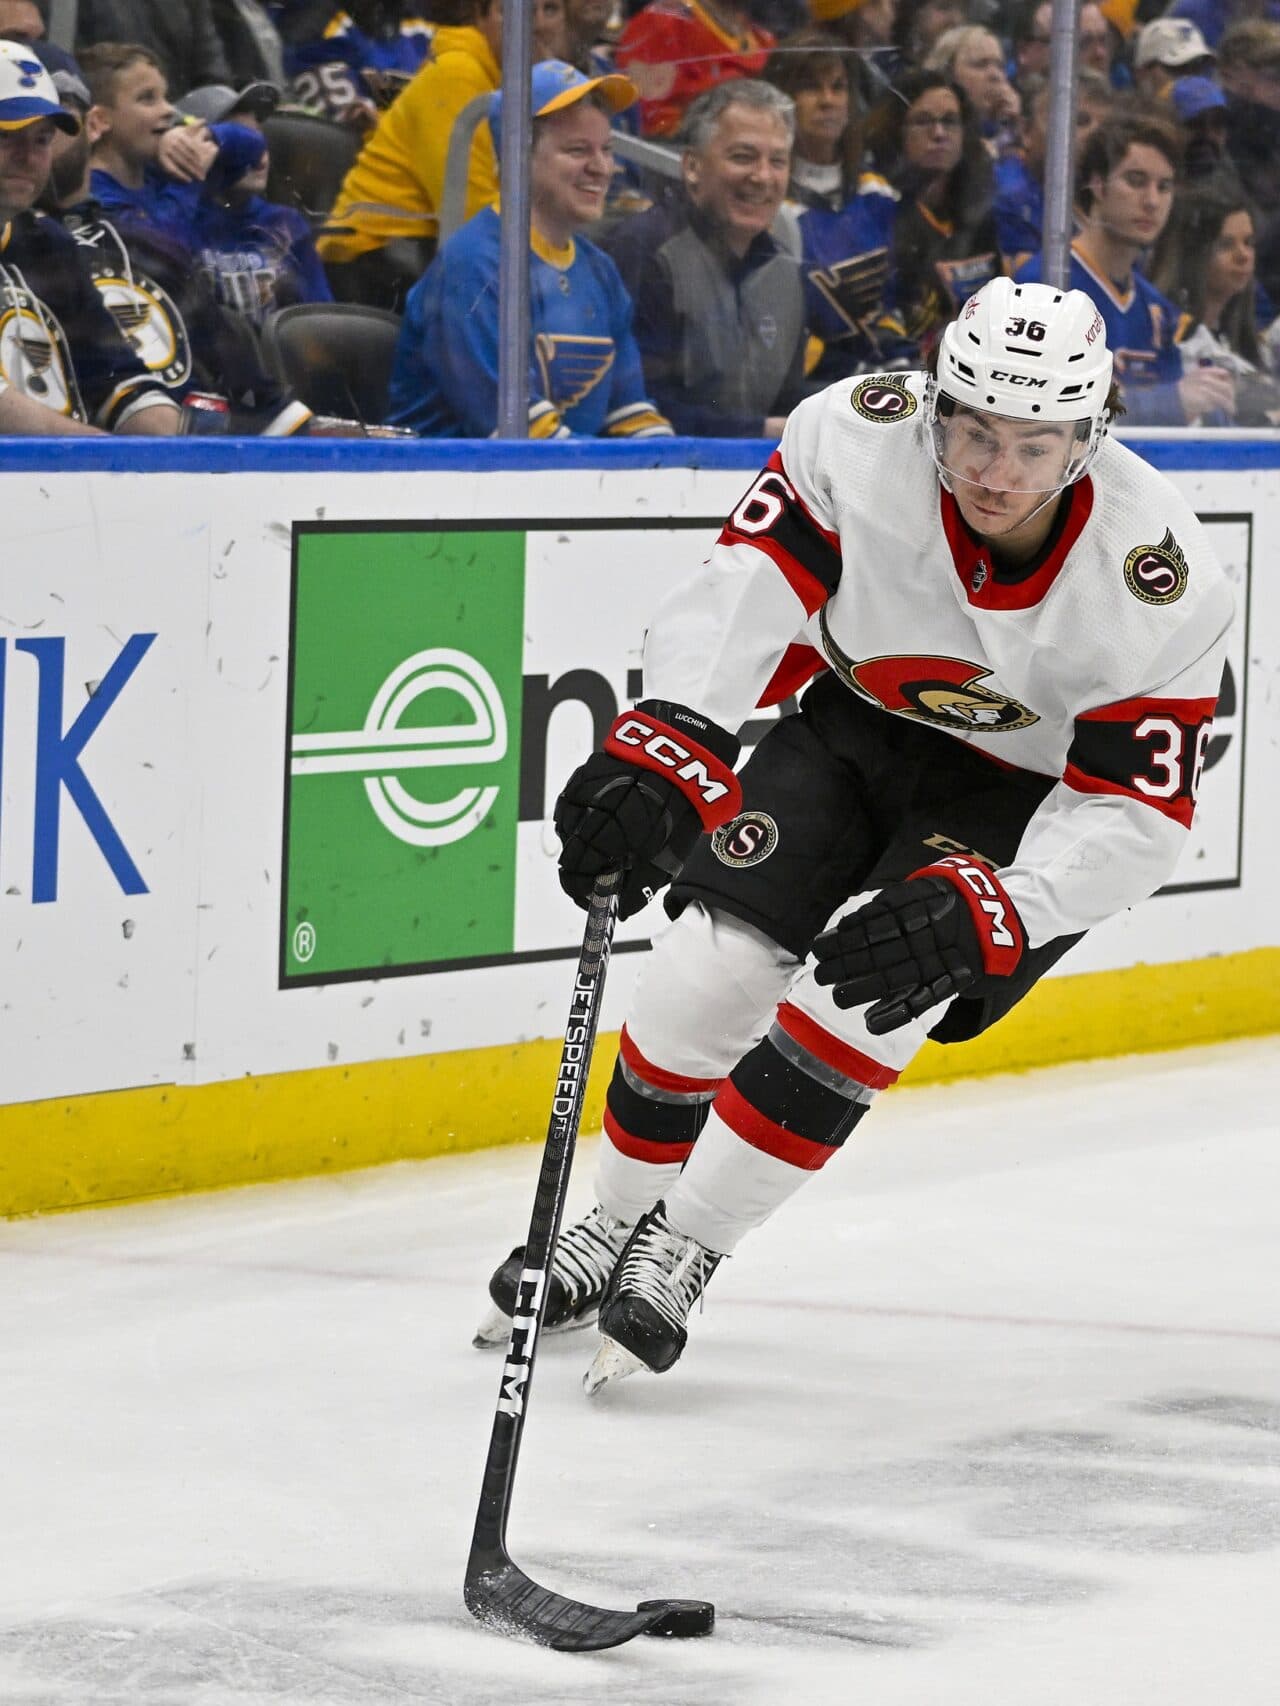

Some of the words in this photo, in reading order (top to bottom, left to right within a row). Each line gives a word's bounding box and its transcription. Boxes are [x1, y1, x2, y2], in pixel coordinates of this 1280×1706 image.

[1005, 316, 1047, 342] 36
[990, 369, 1048, 388] CCM
[614, 719, 730, 804] CCM
[674, 712, 708, 731] LUCCHINI
[0, 633, 159, 904] K
[928, 856, 1015, 947] CCM
[552, 972, 595, 1117] JETSPEED
[496, 1268, 546, 1417] CCM
